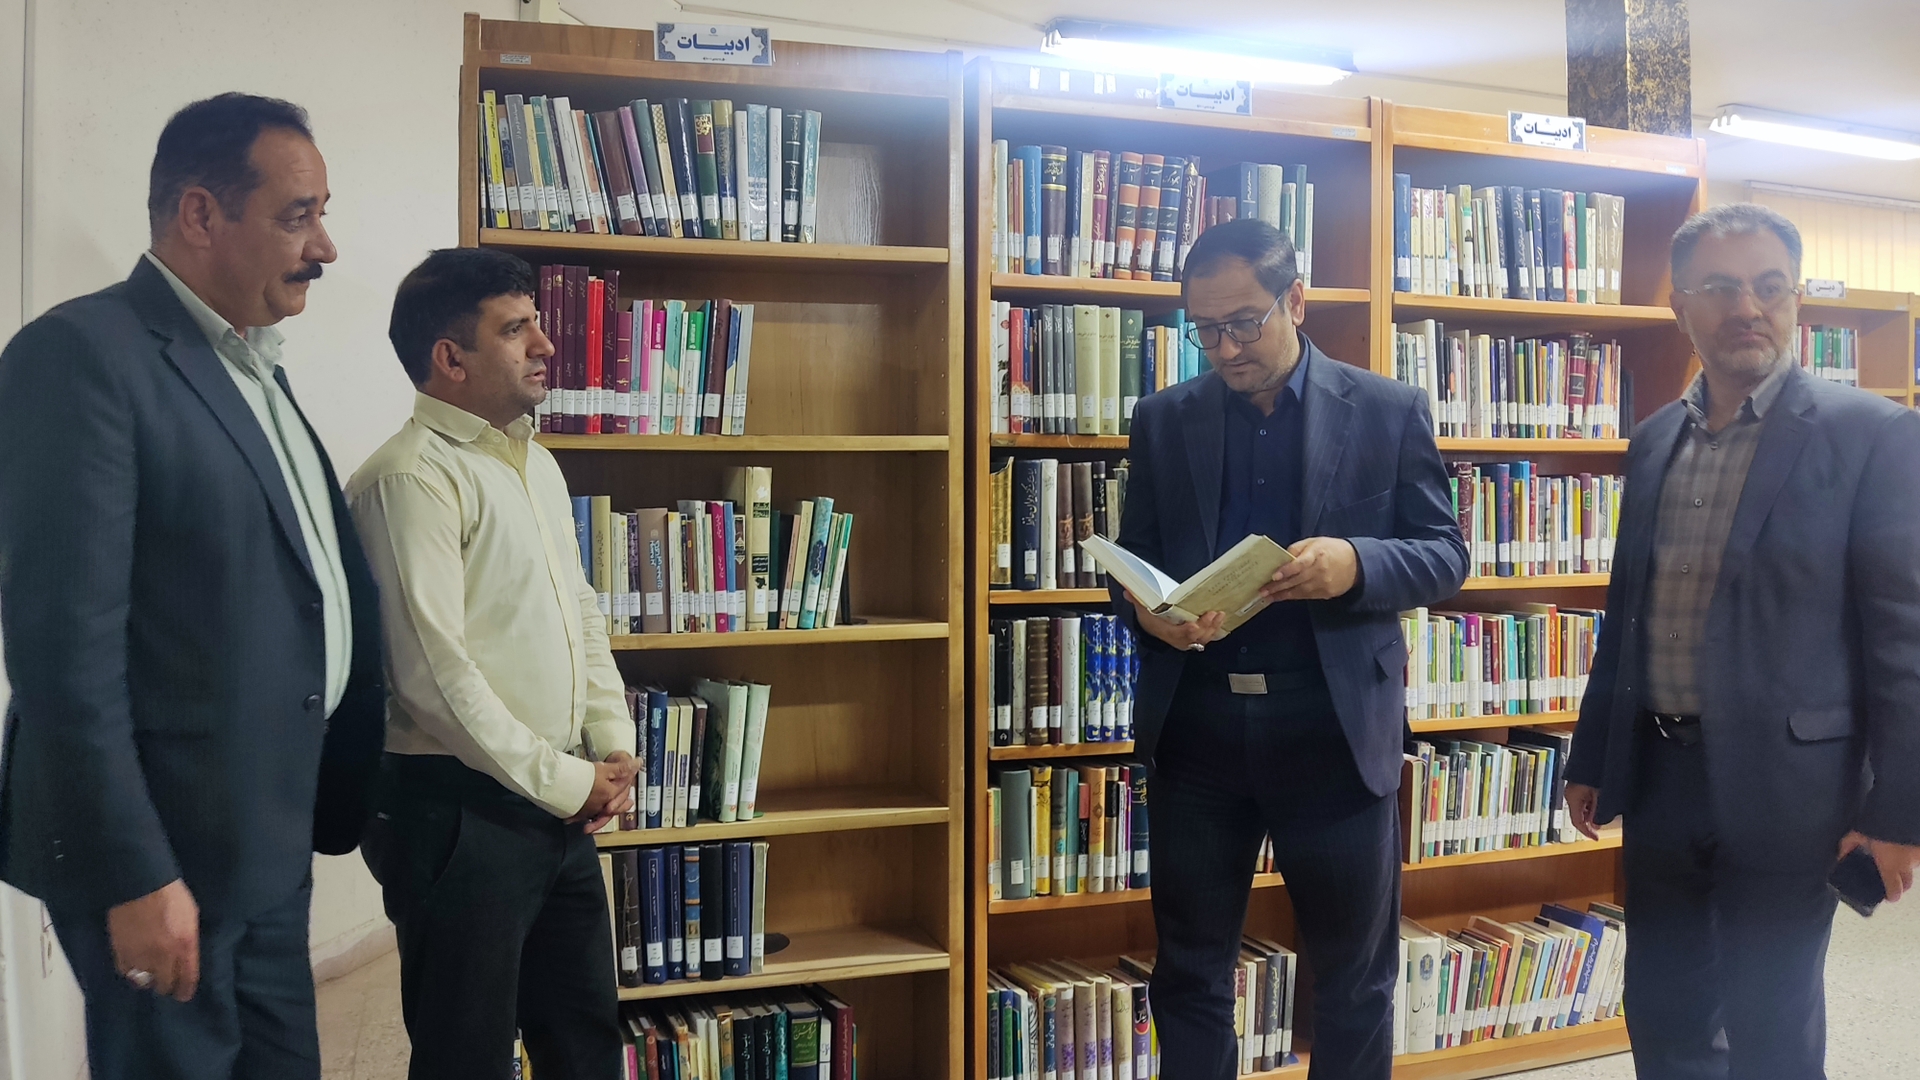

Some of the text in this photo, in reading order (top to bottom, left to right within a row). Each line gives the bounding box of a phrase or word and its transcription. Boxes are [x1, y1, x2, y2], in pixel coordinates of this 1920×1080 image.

[677, 33, 749, 55] ادبیات
[1176, 82, 1235, 104] ادبیات
[1523, 122, 1571, 141] ادبیات
[1412, 994, 1436, 1013] راز دل
